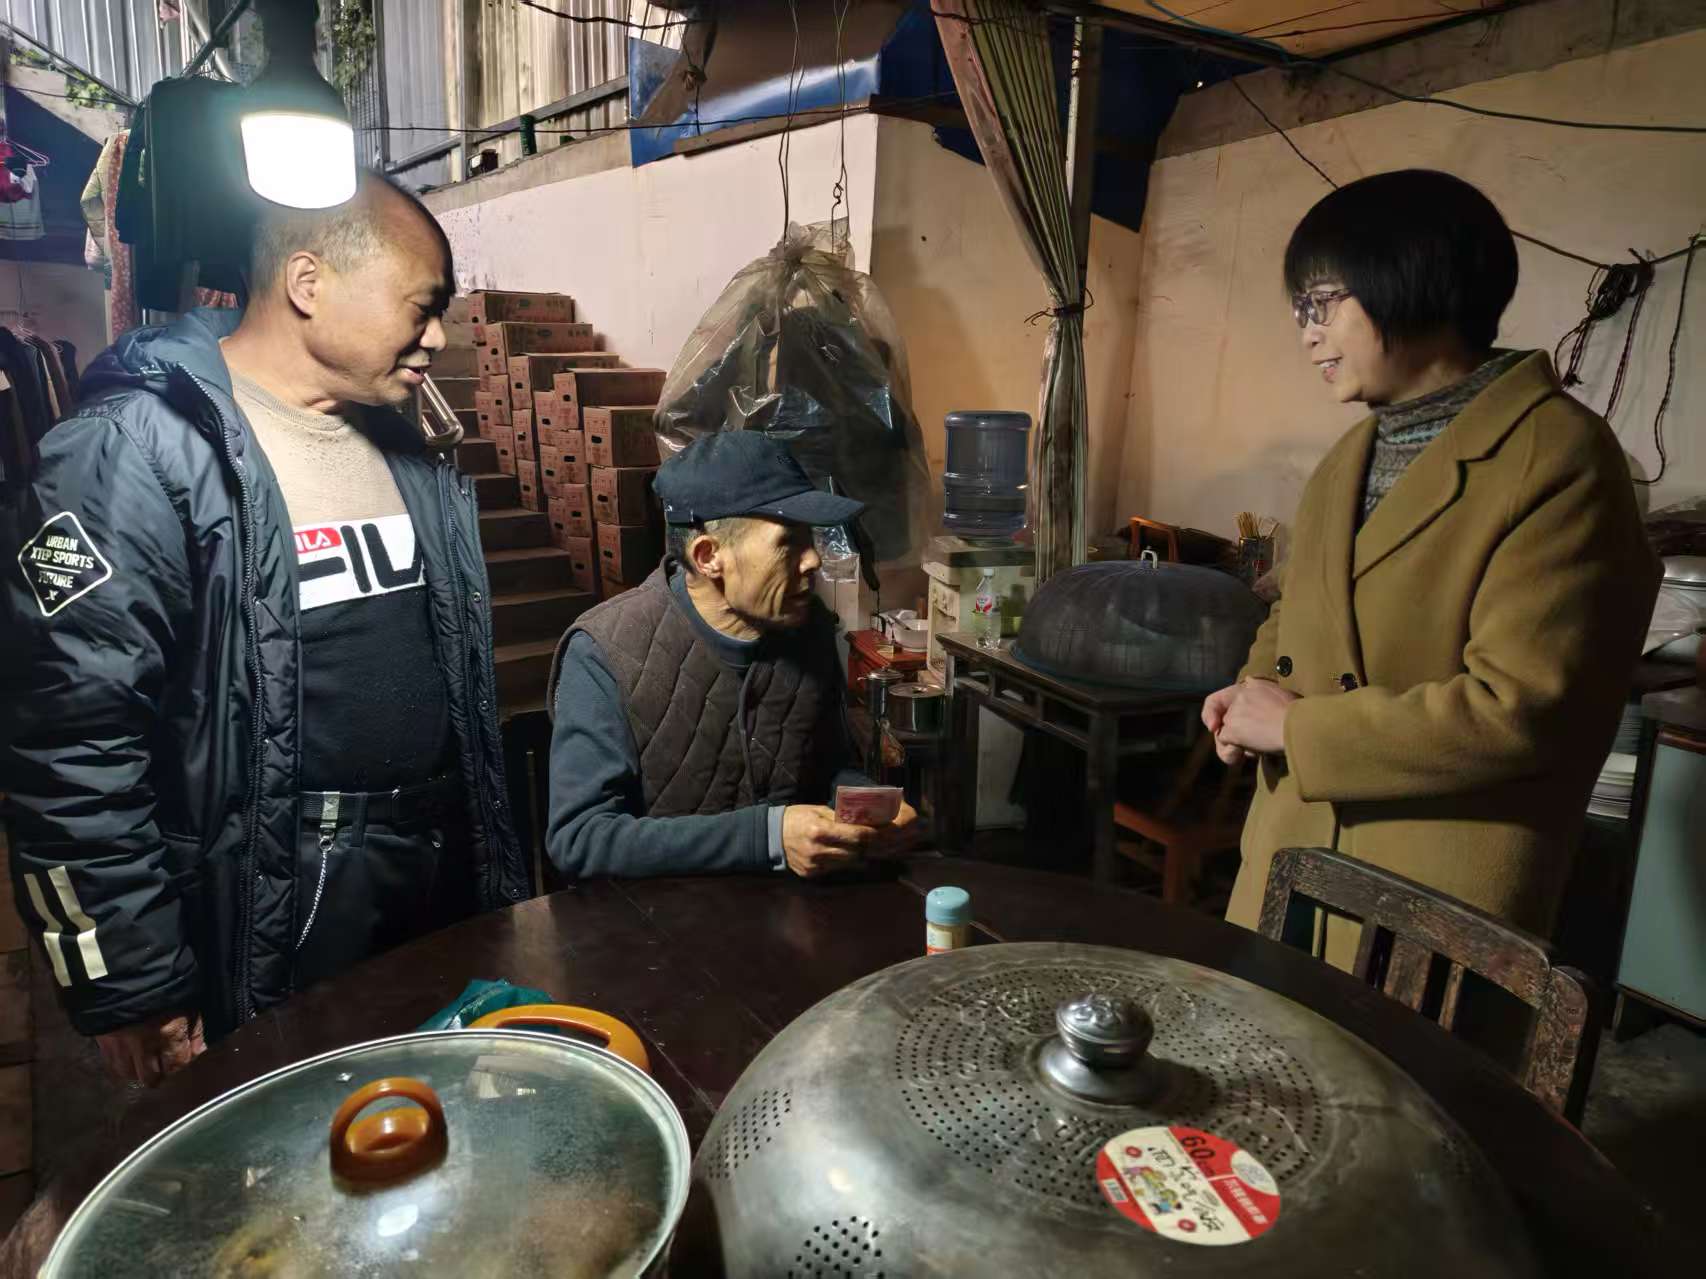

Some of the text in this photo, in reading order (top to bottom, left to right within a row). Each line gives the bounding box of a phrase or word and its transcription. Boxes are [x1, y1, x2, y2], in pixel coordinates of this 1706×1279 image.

[46, 535, 78, 551] URBAN
[294, 530, 332, 551] ILA
[30, 546, 94, 569] XTEP SPORTS
[38, 570, 73, 588] FUTURE
